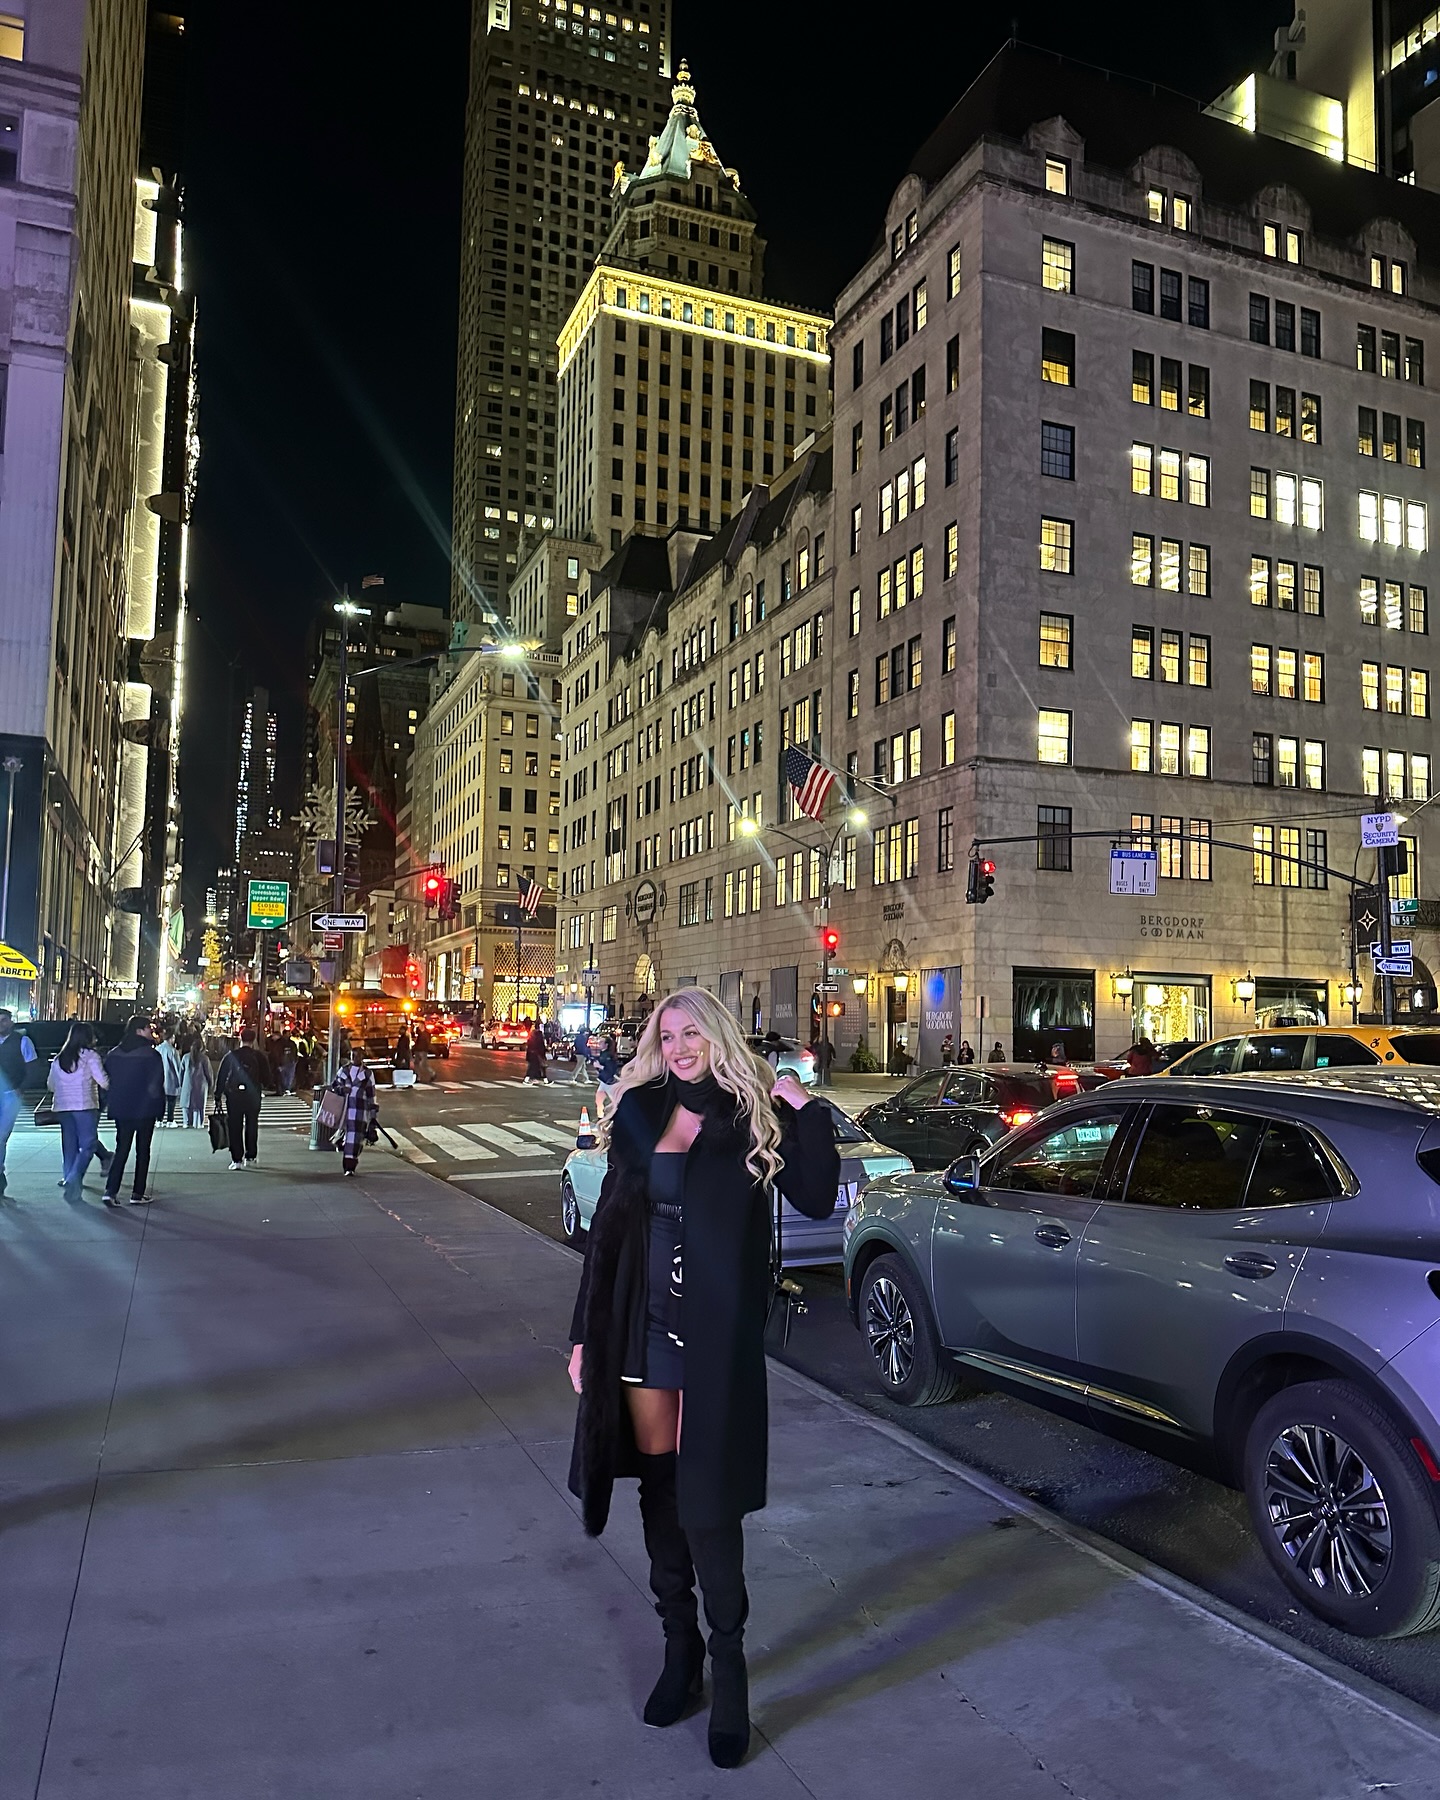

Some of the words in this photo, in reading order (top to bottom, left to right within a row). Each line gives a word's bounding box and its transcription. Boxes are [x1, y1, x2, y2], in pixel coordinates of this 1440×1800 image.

[1367, 815, 1391, 824] NYPD
[1363, 830, 1397, 839] SECURITY
[1365, 837, 1396, 846] CAMERA
[1399, 901, 1406, 911] 5
[321, 918, 337, 926] ONE
[1140, 915, 1204, 928] BERGDORF
[1140, 927, 1204, 939] GOODMAN
[1381, 962, 1392, 970] ONE
[925, 1010, 953, 1020] BERGDORF
[925, 1019, 953, 1030] GOODMAN
